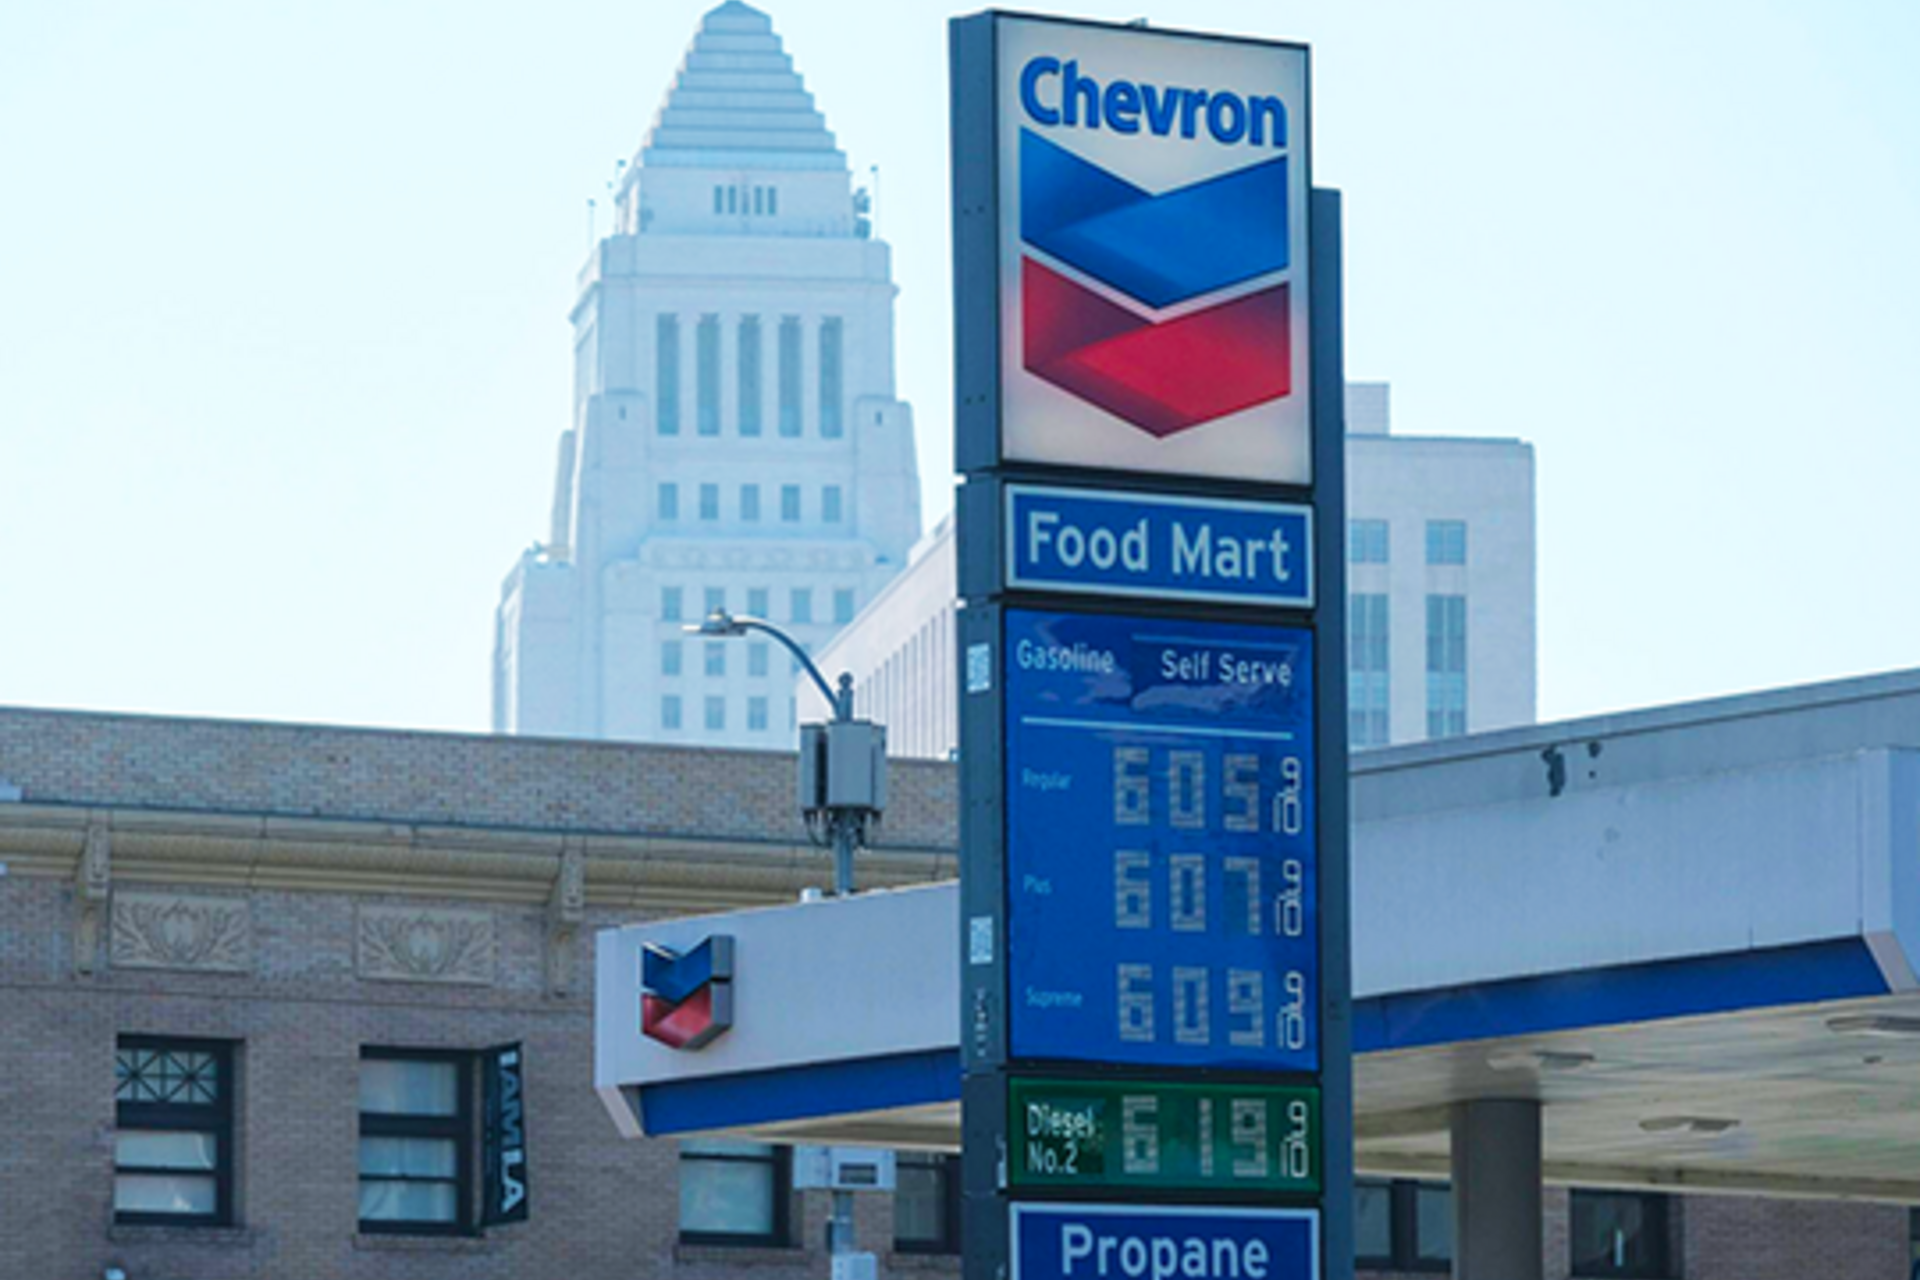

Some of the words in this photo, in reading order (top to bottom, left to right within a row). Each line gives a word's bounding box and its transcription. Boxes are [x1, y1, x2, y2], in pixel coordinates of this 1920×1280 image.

[1019, 55, 1288, 149] Chevron
[1028, 510, 1149, 573] Food
[1171, 521, 1290, 582] Mart
[1017, 640, 1114, 673] Gasoline
[1161, 650, 1210, 680] Self
[1218, 654, 1292, 687] Serve
[1114, 747, 1260, 832] 605
[1115, 850, 1262, 935] 607
[1025, 985, 1083, 1009] Supreme
[1117, 963, 1265, 1047] 609
[1027, 1103, 1095, 1137] Diesel
[1122, 1095, 1269, 1177] 619
[1028, 1142, 1078, 1173] No.2
[1061, 1223, 1269, 1280] Propane
